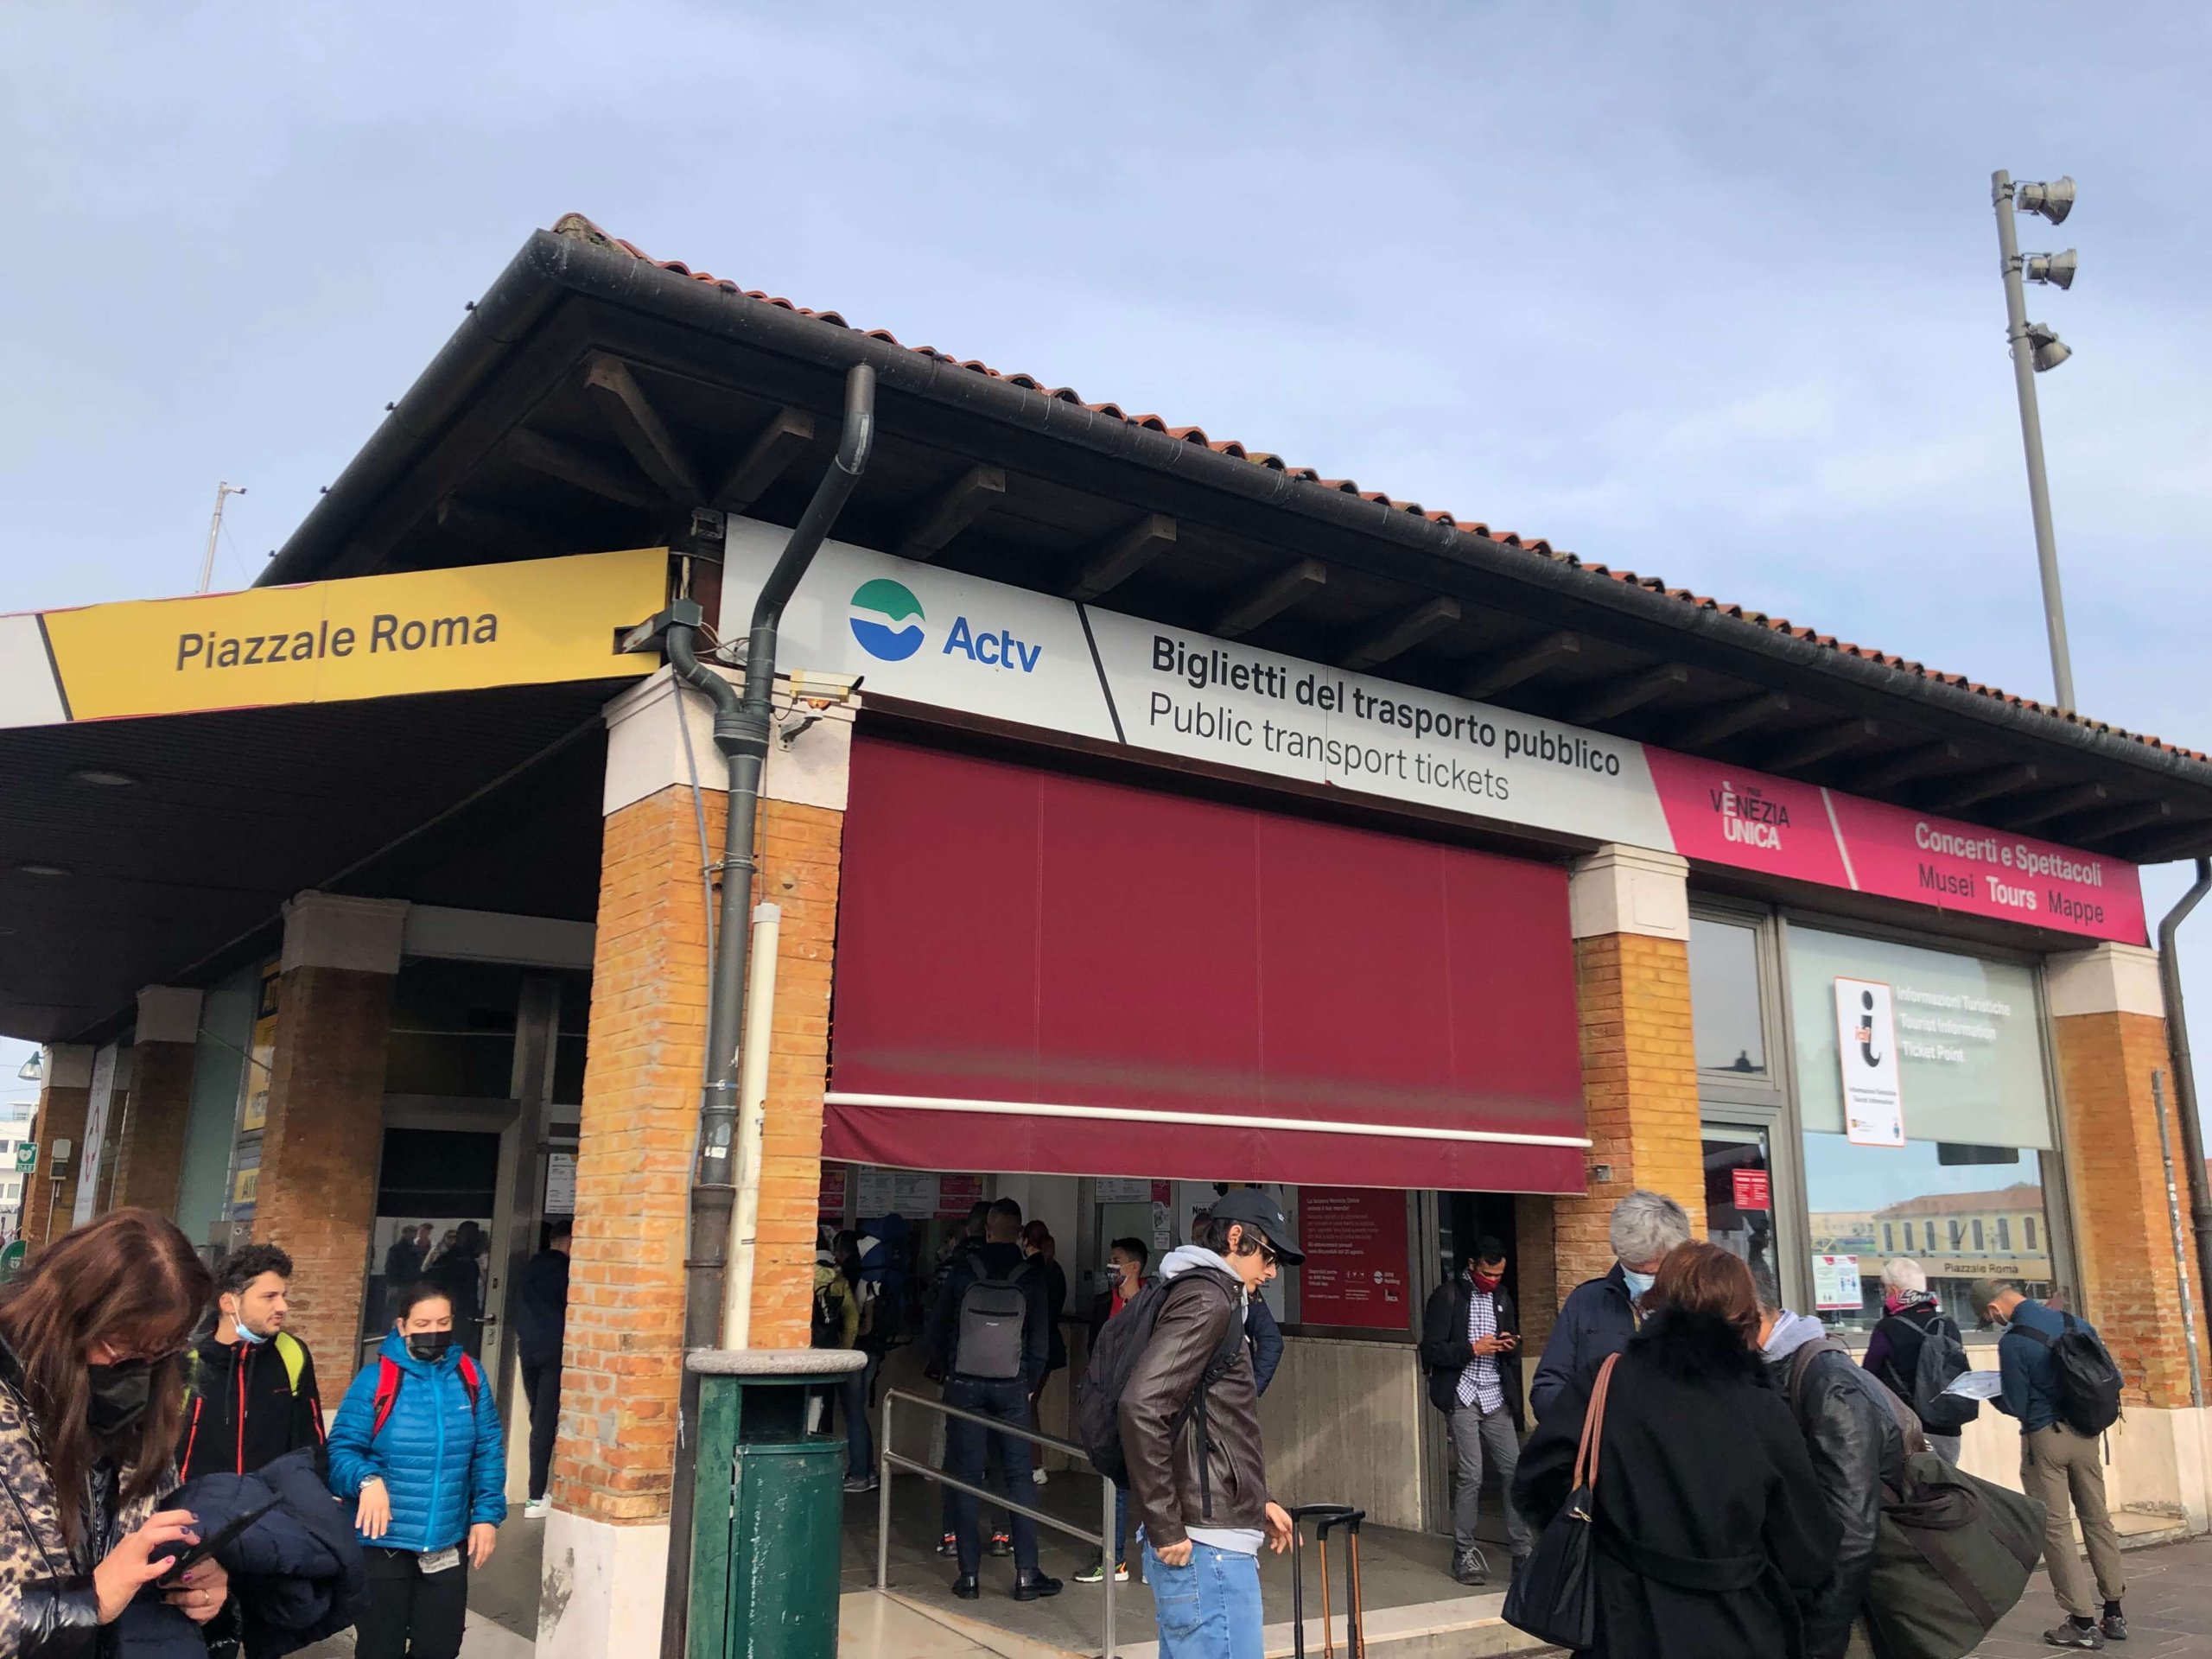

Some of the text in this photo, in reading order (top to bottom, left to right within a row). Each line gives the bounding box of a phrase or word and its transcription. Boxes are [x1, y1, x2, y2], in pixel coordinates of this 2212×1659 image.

[175, 612, 498, 671] Piazzale Roma
[943, 616, 1042, 673] Actv
[1153, 635, 1620, 776] Biglietti del trasporto pubblico
[1150, 691, 1509, 800] Public transport tickets
[1723, 817, 1781, 850] UNICA
[1915, 821, 2102, 887] Concerti e Spettacoli
[1918, 863, 2104, 926] Musei Tours Mappe
[1896, 985, 2012, 1016] Informazioni Turistiche
[1899, 1013, 1997, 1039] Tourist Information
[1903, 1040, 1965, 1063] Ticket Point
[1944, 1262, 2019, 1274] Piazzale Roma
